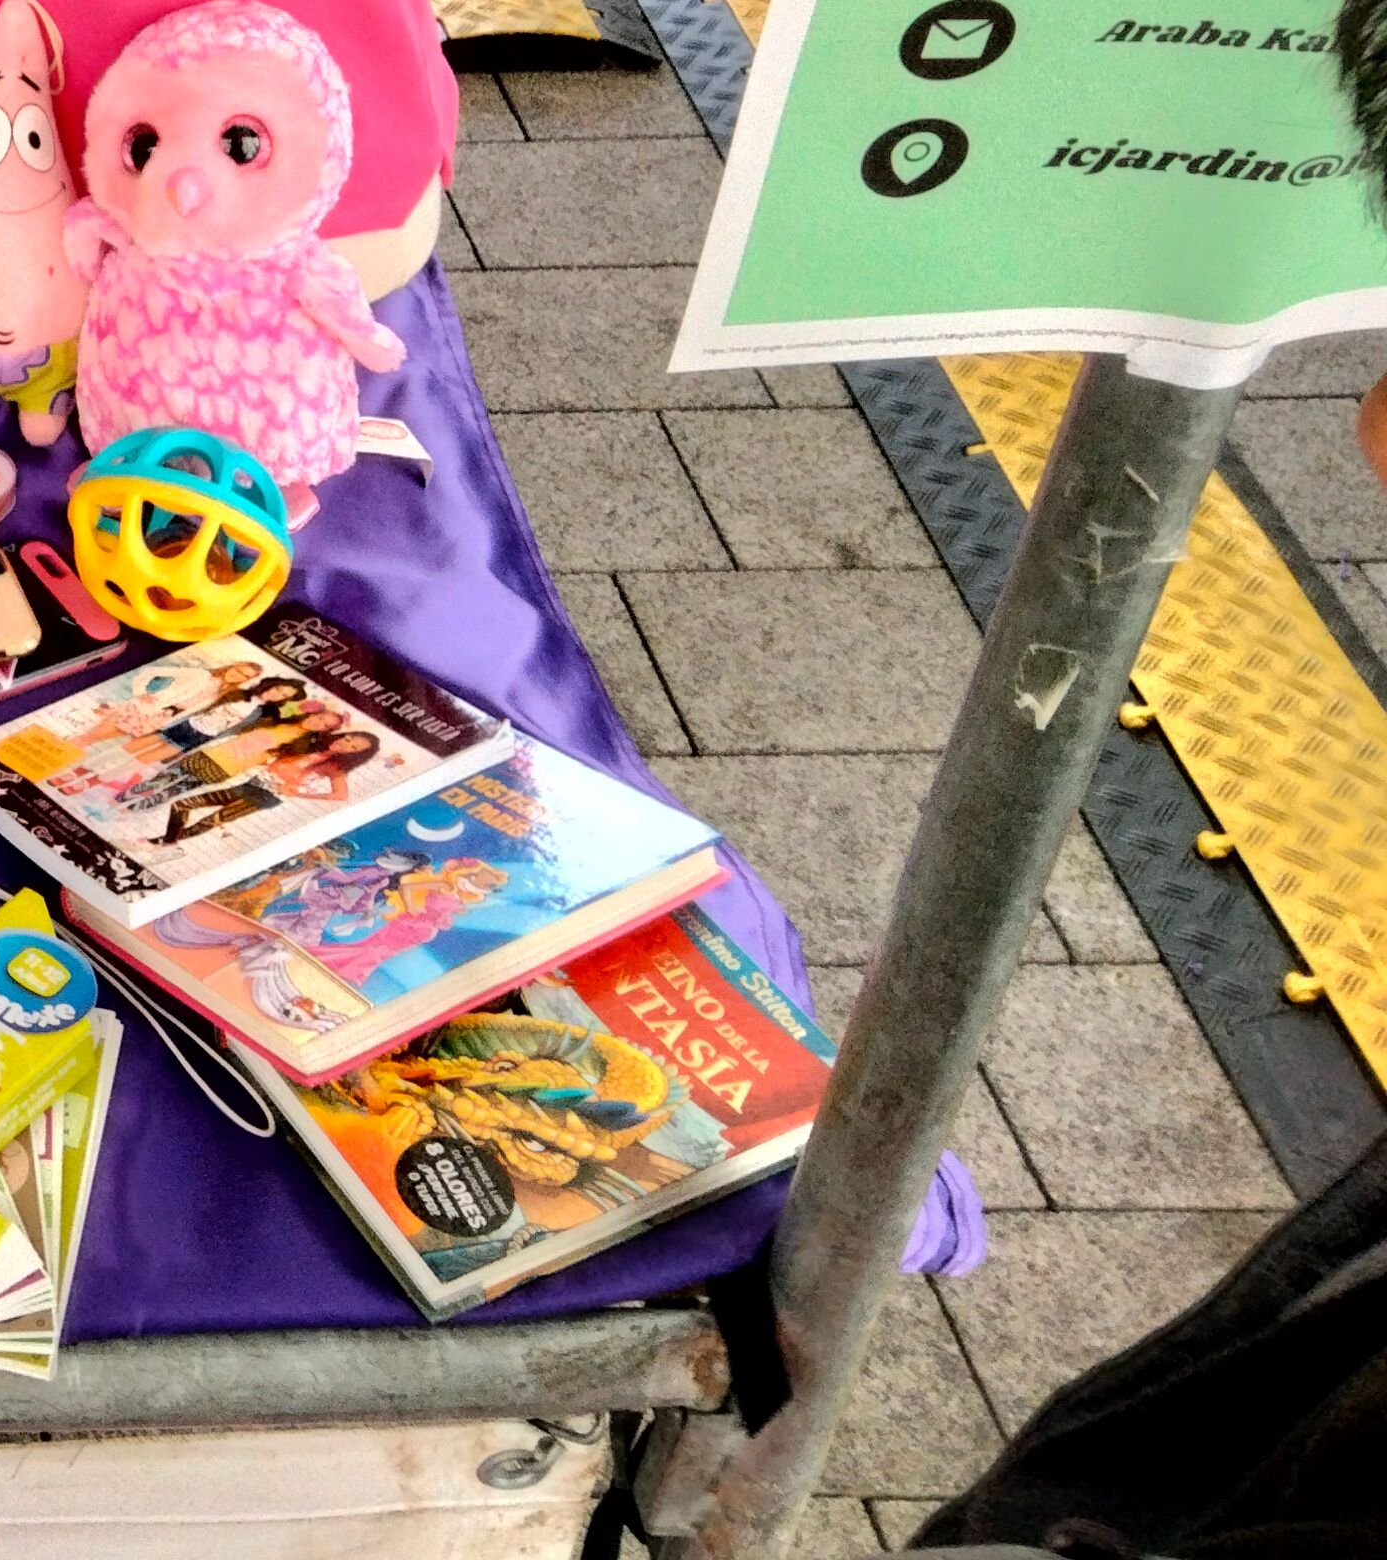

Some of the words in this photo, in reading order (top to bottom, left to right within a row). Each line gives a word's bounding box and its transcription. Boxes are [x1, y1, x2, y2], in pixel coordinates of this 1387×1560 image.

[1094, 19, 1251, 47] Araba
[438, 786, 478, 808] EN
[739, 972, 806, 1040] Stilton
[715, 1022, 747, 1051] DE
[742, 1050, 770, 1075] LA
[425, 1142, 445, 1156] 8
[408, 1172, 421, 1181] O
